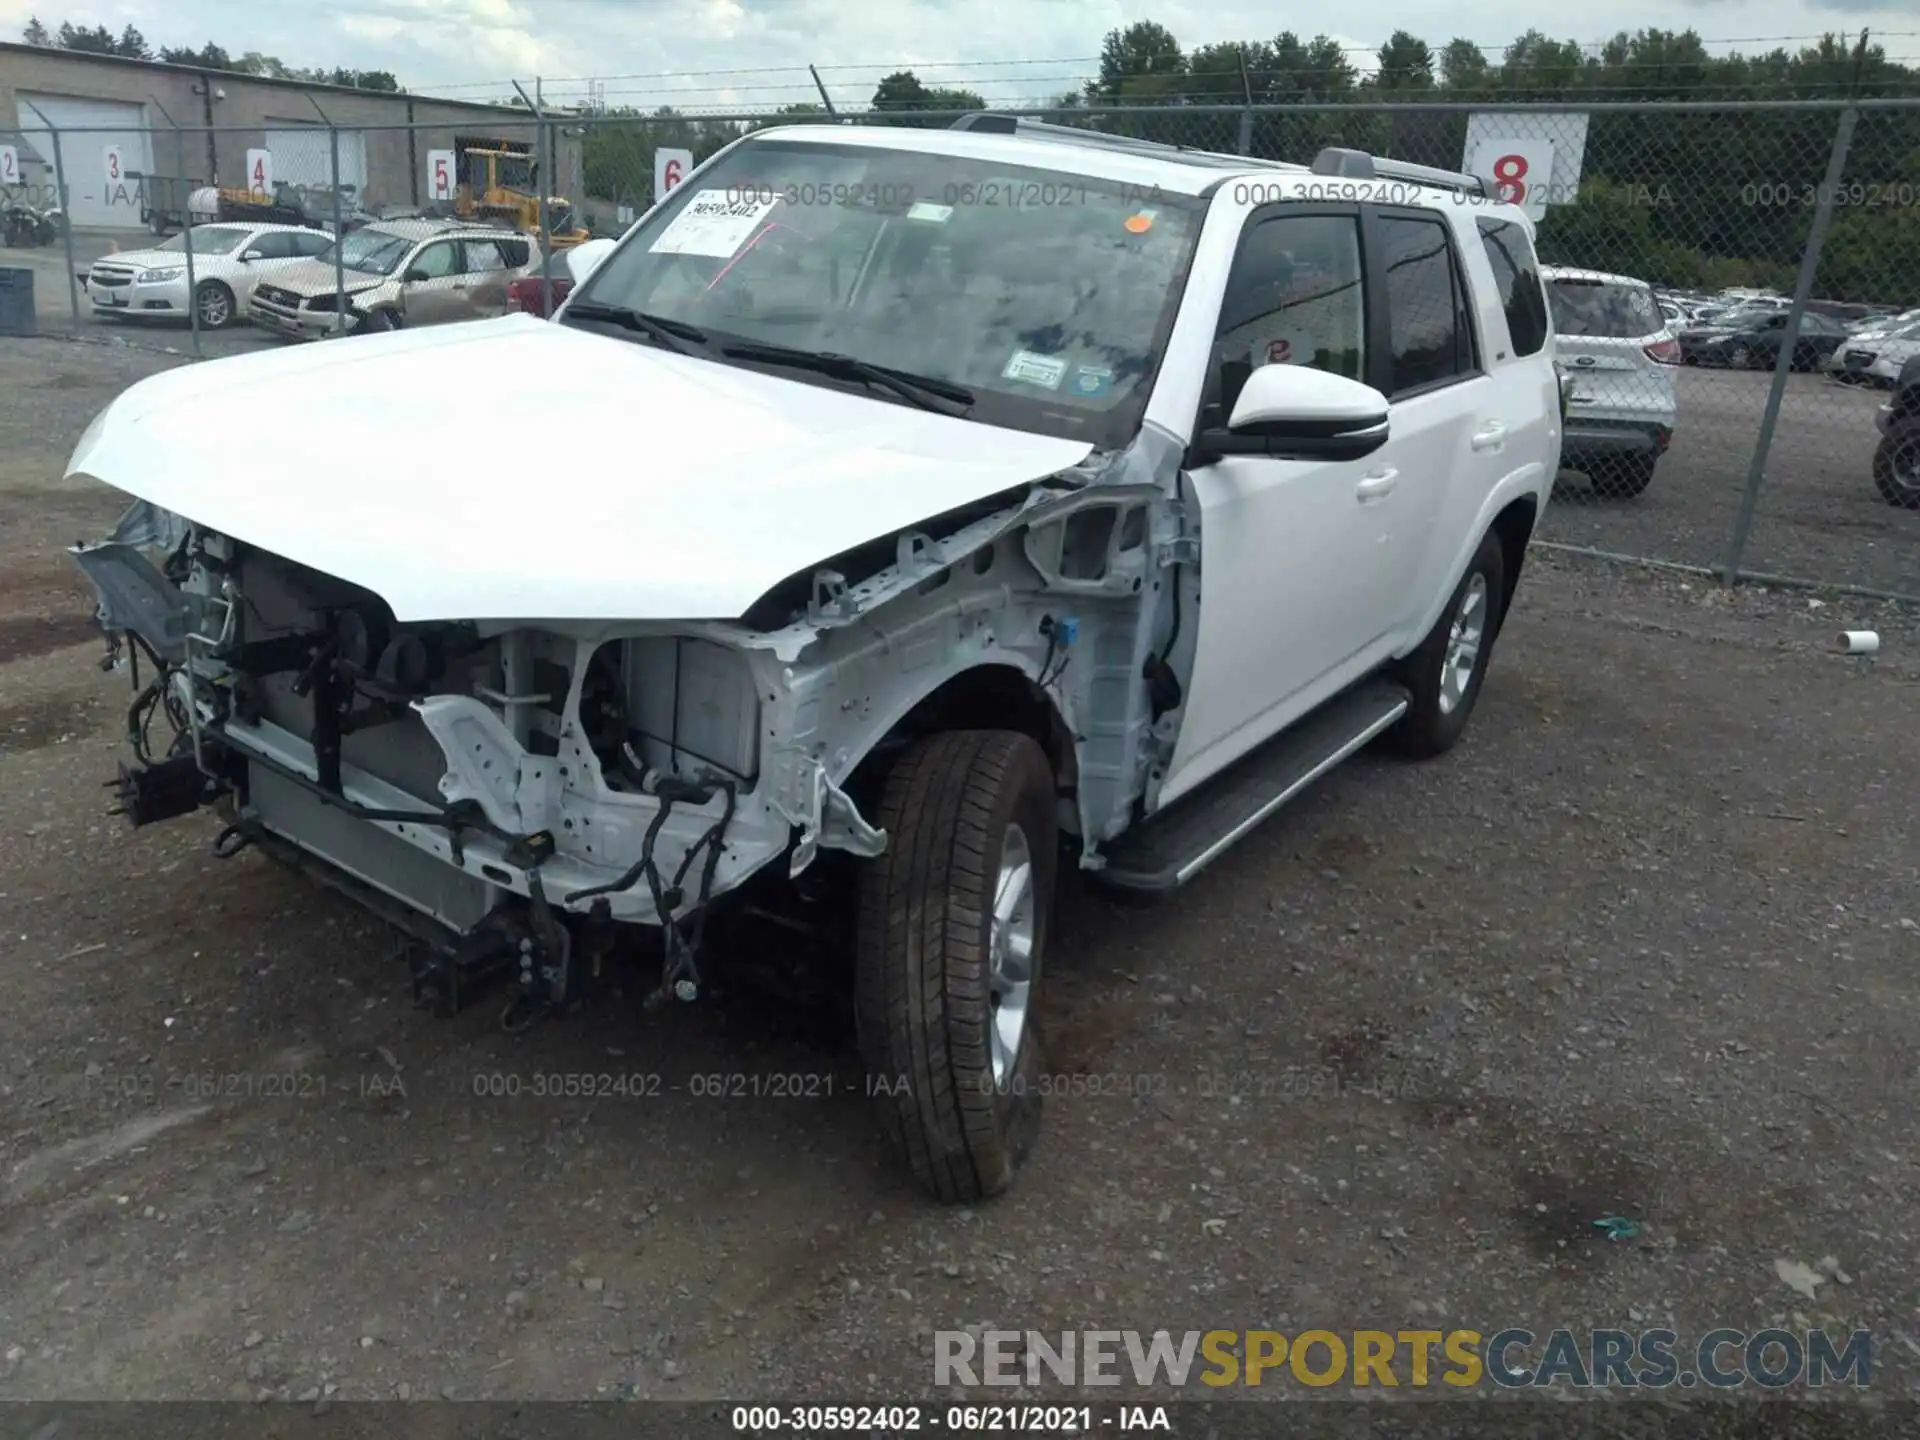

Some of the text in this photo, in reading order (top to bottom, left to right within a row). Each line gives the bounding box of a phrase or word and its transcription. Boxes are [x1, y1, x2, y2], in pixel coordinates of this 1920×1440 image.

[4, 152, 15, 176] 2
[109, 153, 119, 180] 3
[252, 158, 265, 187] 4
[435, 160, 448, 191] 5
[664, 160, 681, 192] 6
[1494, 154, 1528, 205] 8
